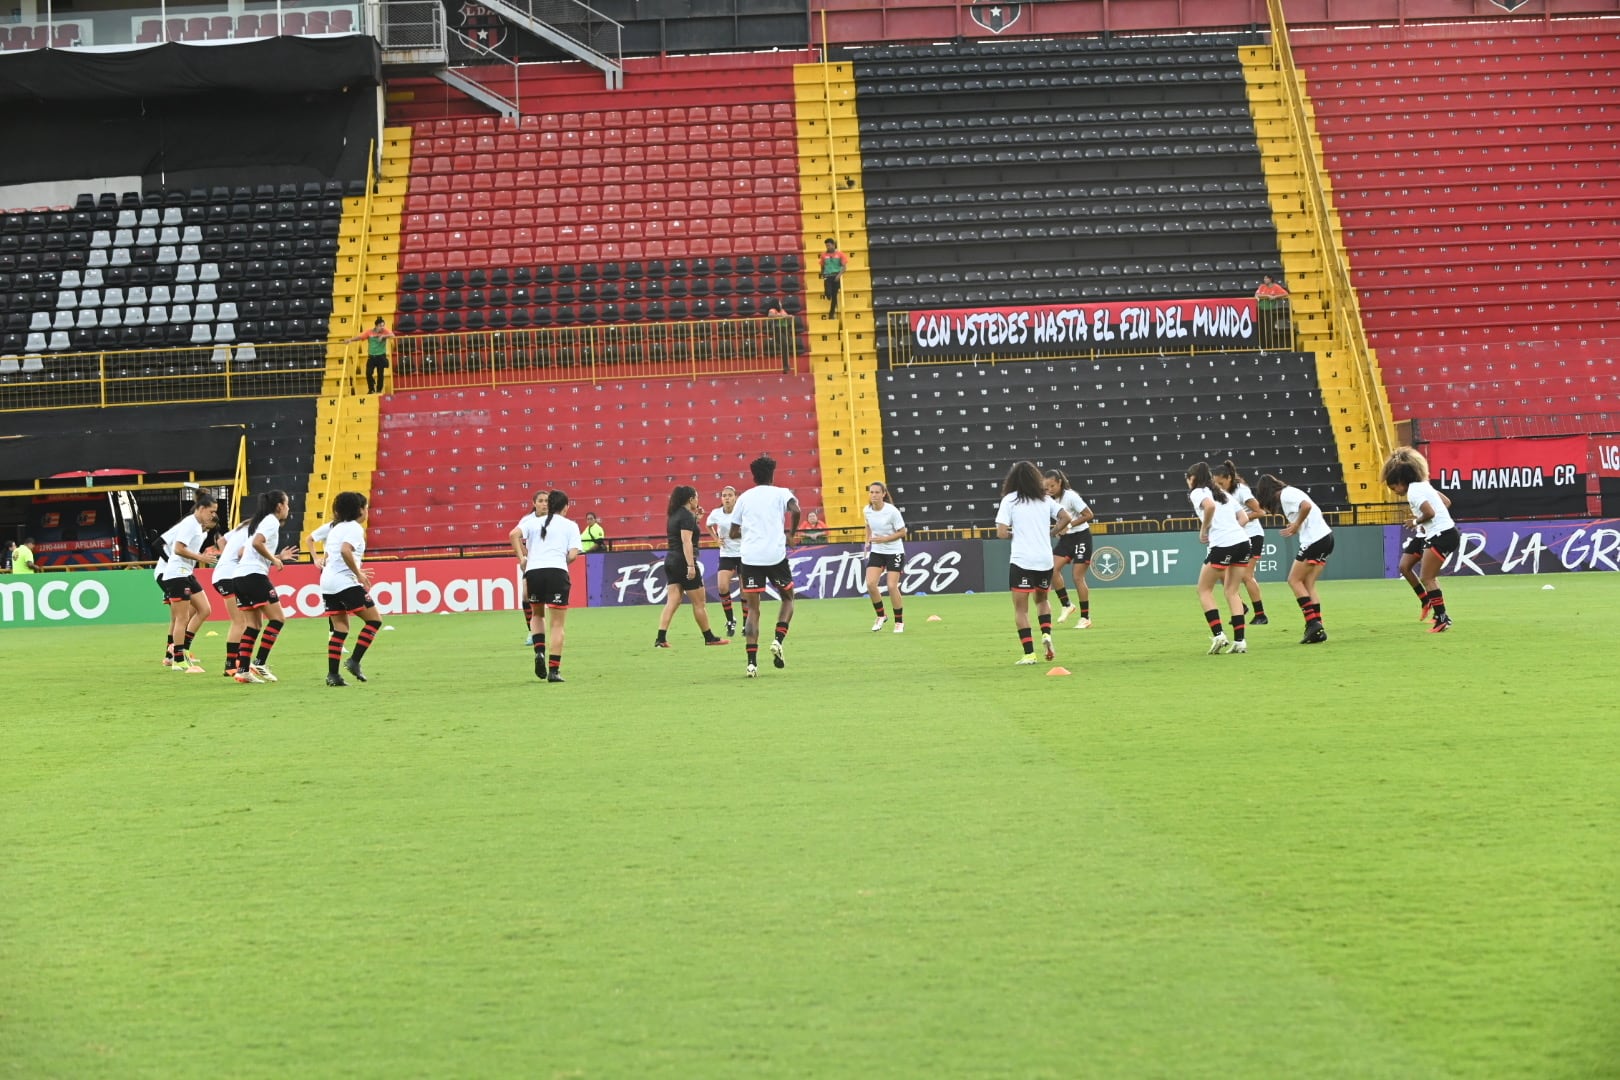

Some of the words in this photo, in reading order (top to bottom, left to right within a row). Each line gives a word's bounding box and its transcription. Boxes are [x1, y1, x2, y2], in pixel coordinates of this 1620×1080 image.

[916, 312, 951, 348] CON
[956, 310, 1028, 346] USTEDES
[1034, 308, 1088, 344] HASTA
[1093, 308, 1114, 341] EL
[1120, 307, 1150, 340] FIN
[1155, 306, 1188, 339] DEL
[1192, 305, 1253, 339] MUNDO
[1441, 469, 1461, 490] LA
[1472, 467, 1543, 490] MANADA
[1554, 465, 1576, 486] CR
[895, 553, 902, 563] 3
[1074, 543, 1086, 555] 15
[1500, 532, 1547, 575] LA
[1561, 528, 1620, 575] GR
[1129, 549, 1180, 576] PIF
